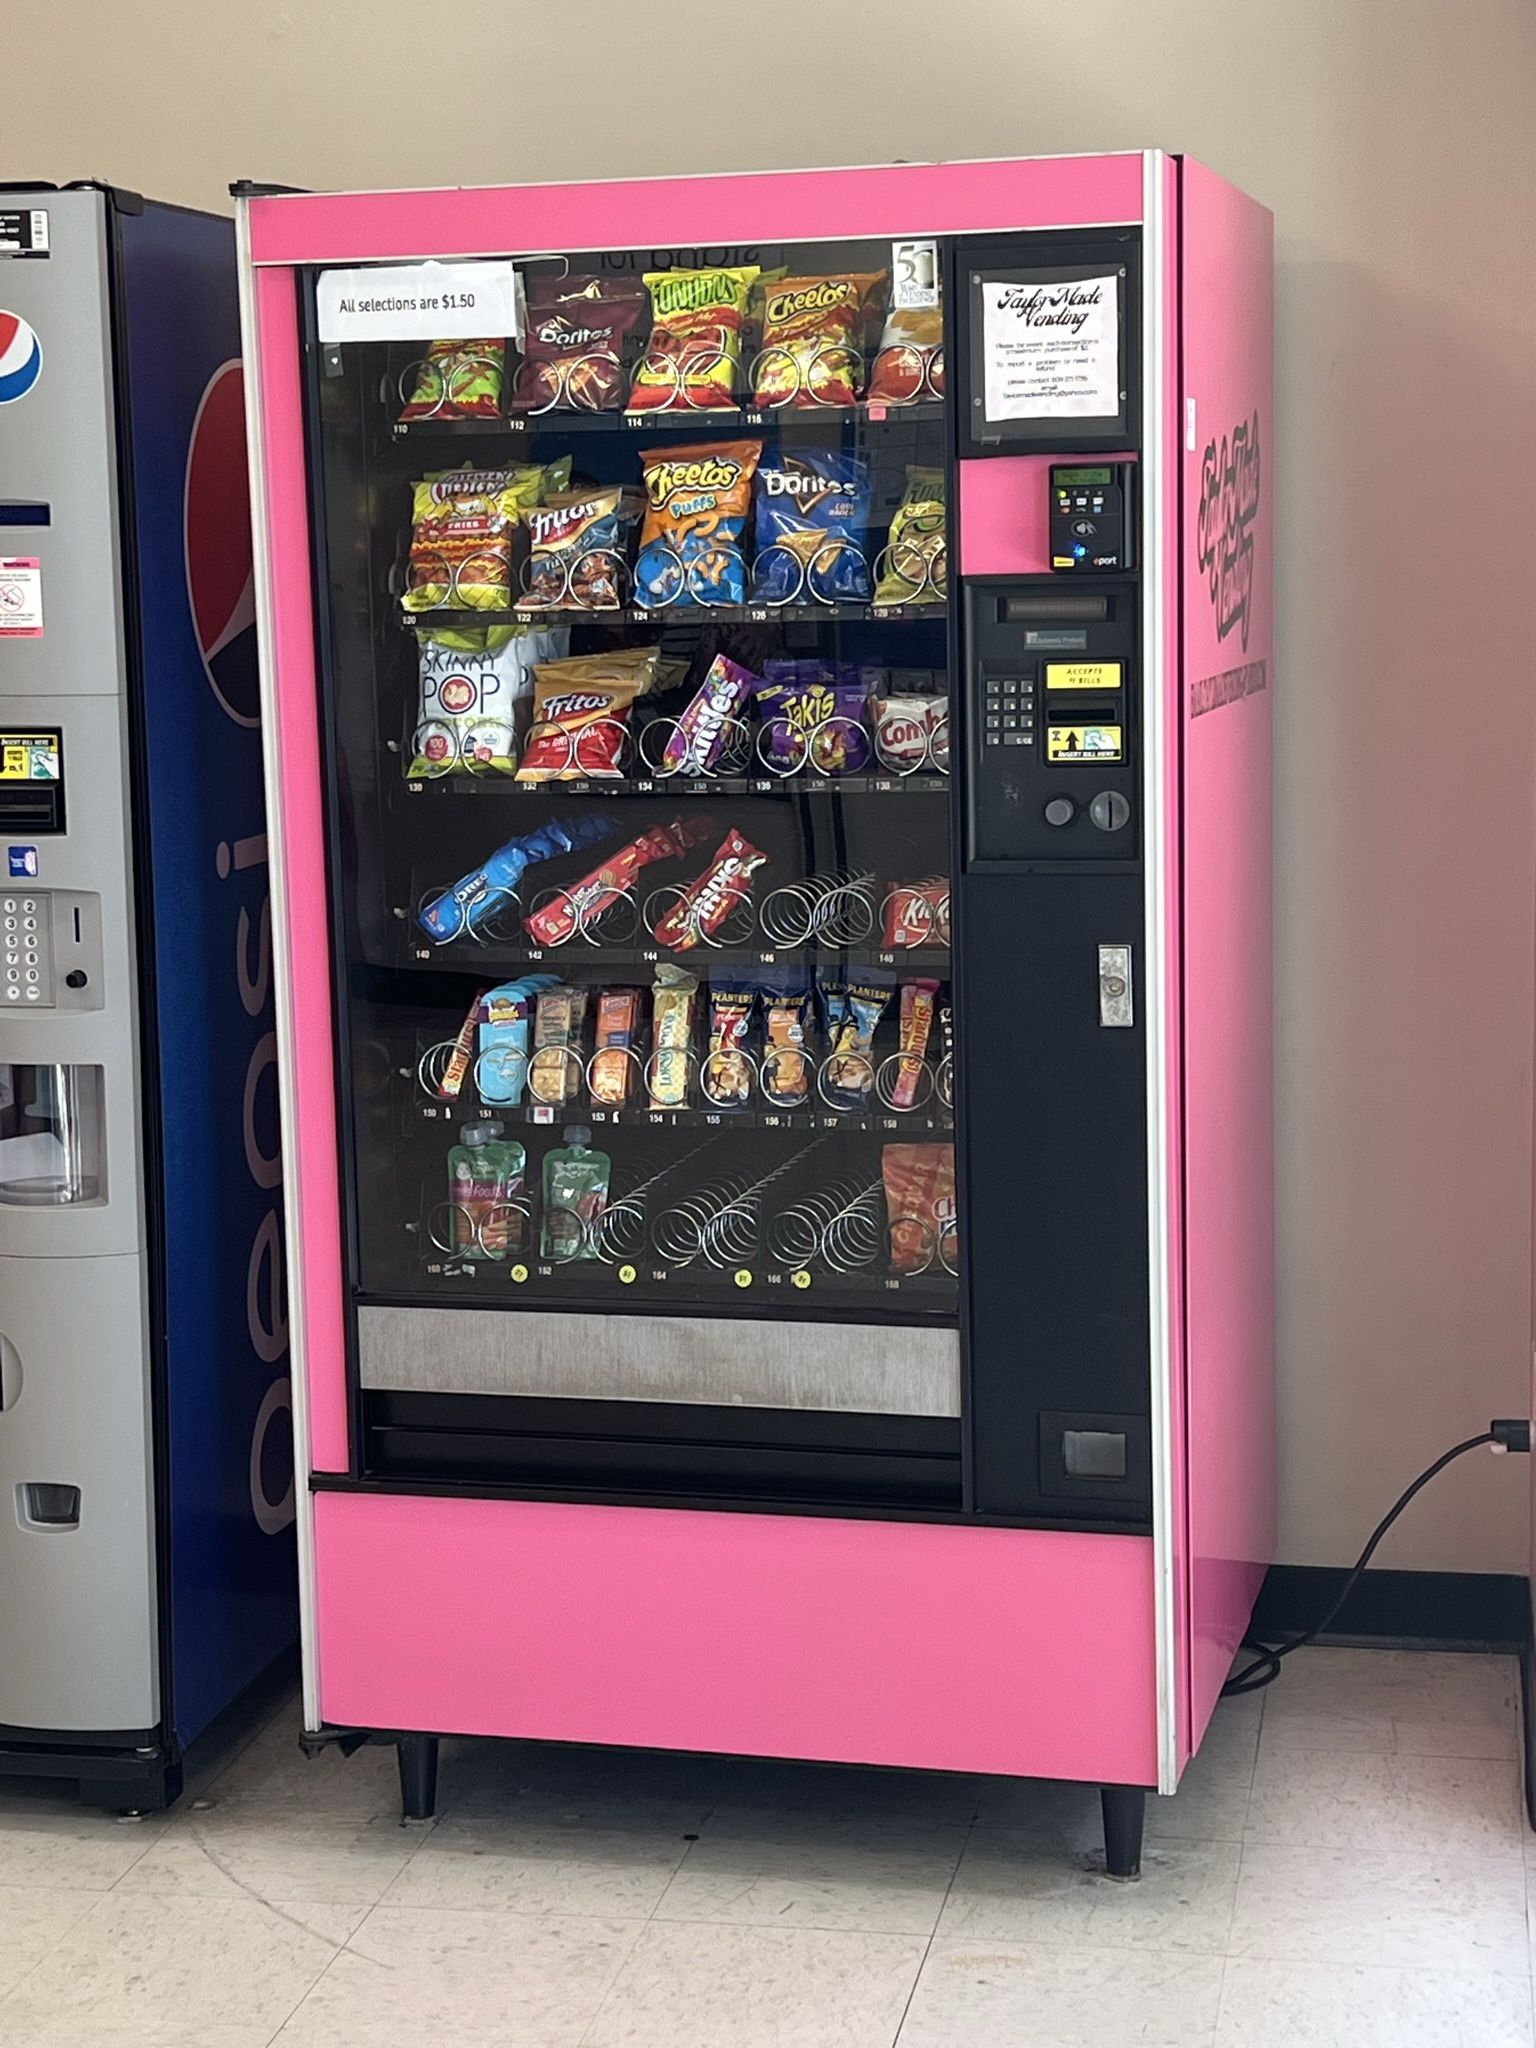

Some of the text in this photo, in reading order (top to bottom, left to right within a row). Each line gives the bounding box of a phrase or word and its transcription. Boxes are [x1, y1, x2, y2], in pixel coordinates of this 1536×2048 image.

[339, 293, 475, 313] All selections are $1.50
[767, 281, 852, 326] Cheetos
[997, 285, 1103, 318] Taylor Made
[1025, 306, 1090, 334] Vending
[539, 325, 613, 345] Doritos
[510, 420, 525, 431] 112
[628, 417, 643, 427] 114
[644, 459, 742, 510] Cheetos
[766, 471, 858, 497] Doritos
[402, 616, 416, 625] 120
[517, 614, 532, 622] 122
[634, 612, 648, 620] 124
[423, 649, 498, 674] SKINNY
[423, 673, 500, 717] POP
[542, 694, 609, 721] Fritos
[523, 783, 537, 791] 132
[638, 783, 652, 791] 134
[455, 871, 489, 904] OREO
[528, 951, 543, 959] 142
[643, 952, 657, 960] 144
[711, 992, 753, 1003] PLANTERS
[848, 984, 891, 1000] PLANTERS
[764, 996, 804, 1006] PLANTERS
[479, 1110, 491, 1118] 151
[591, 1113, 605, 1121] 153
[706, 1116, 720, 1124] 155
[824, 1118, 837, 1126] 157
